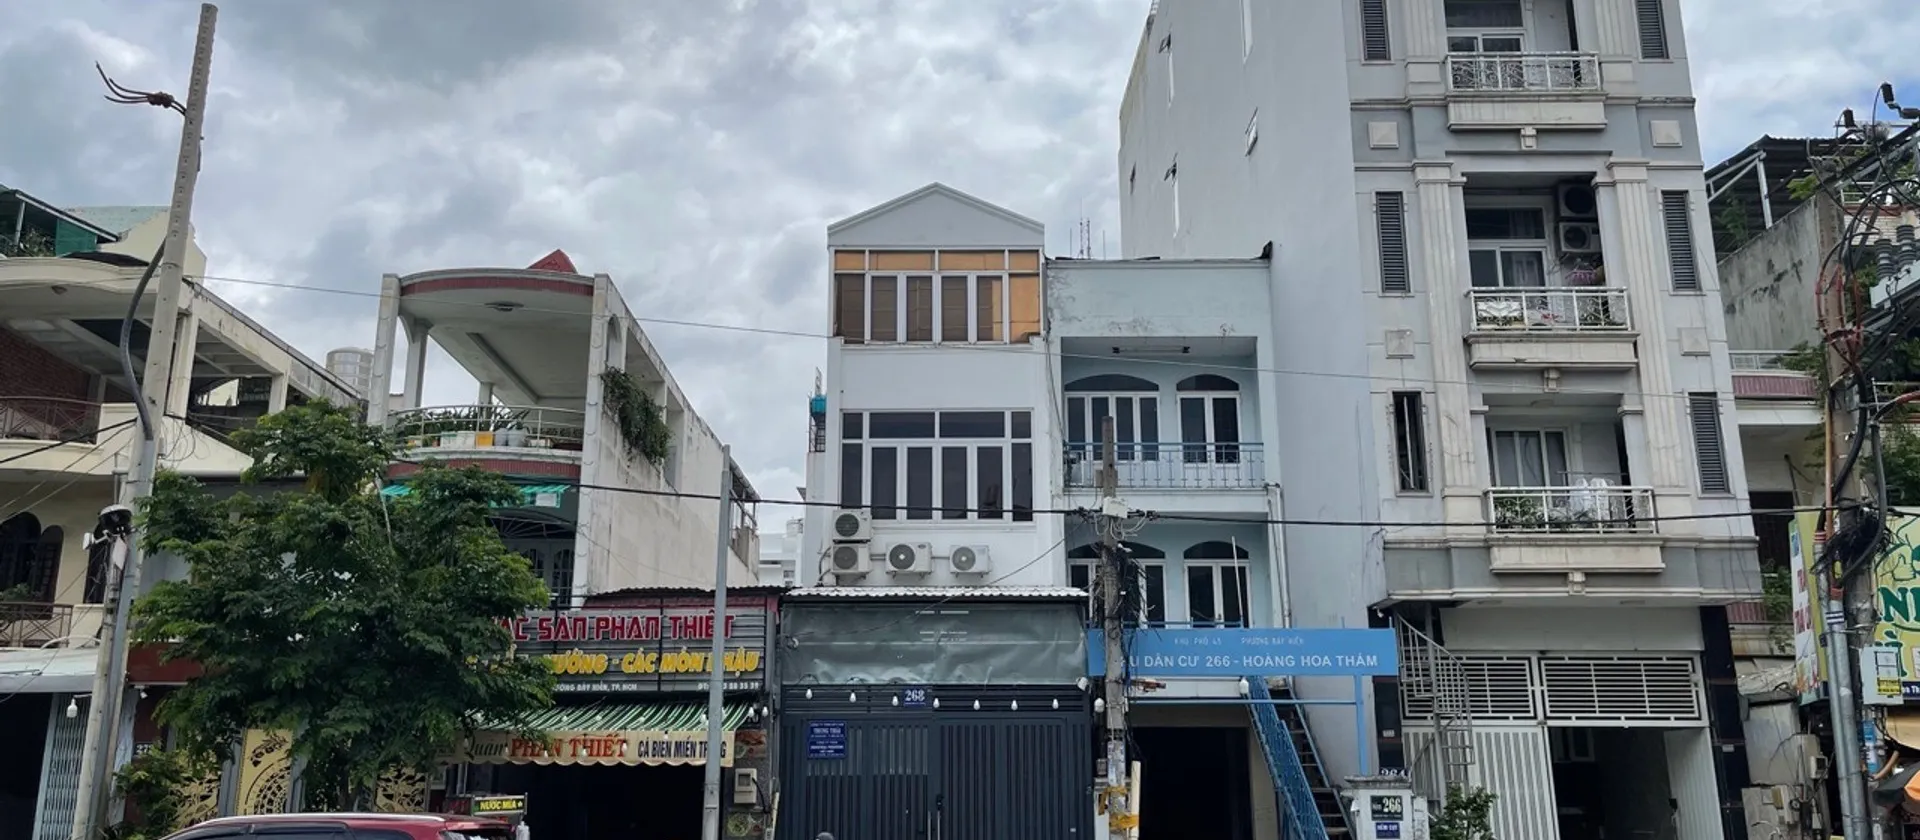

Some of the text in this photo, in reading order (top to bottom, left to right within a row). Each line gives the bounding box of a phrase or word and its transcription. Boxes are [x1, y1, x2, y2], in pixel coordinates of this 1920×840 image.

[595, 615, 661, 641] PHAN
[1178, 655, 1199, 668] CƯ
[1206, 655, 1230, 668] 266
[1301, 655, 1332, 667] HOA
[905, 689, 925, 702] 268
[1383, 797, 1402, 813] 266
